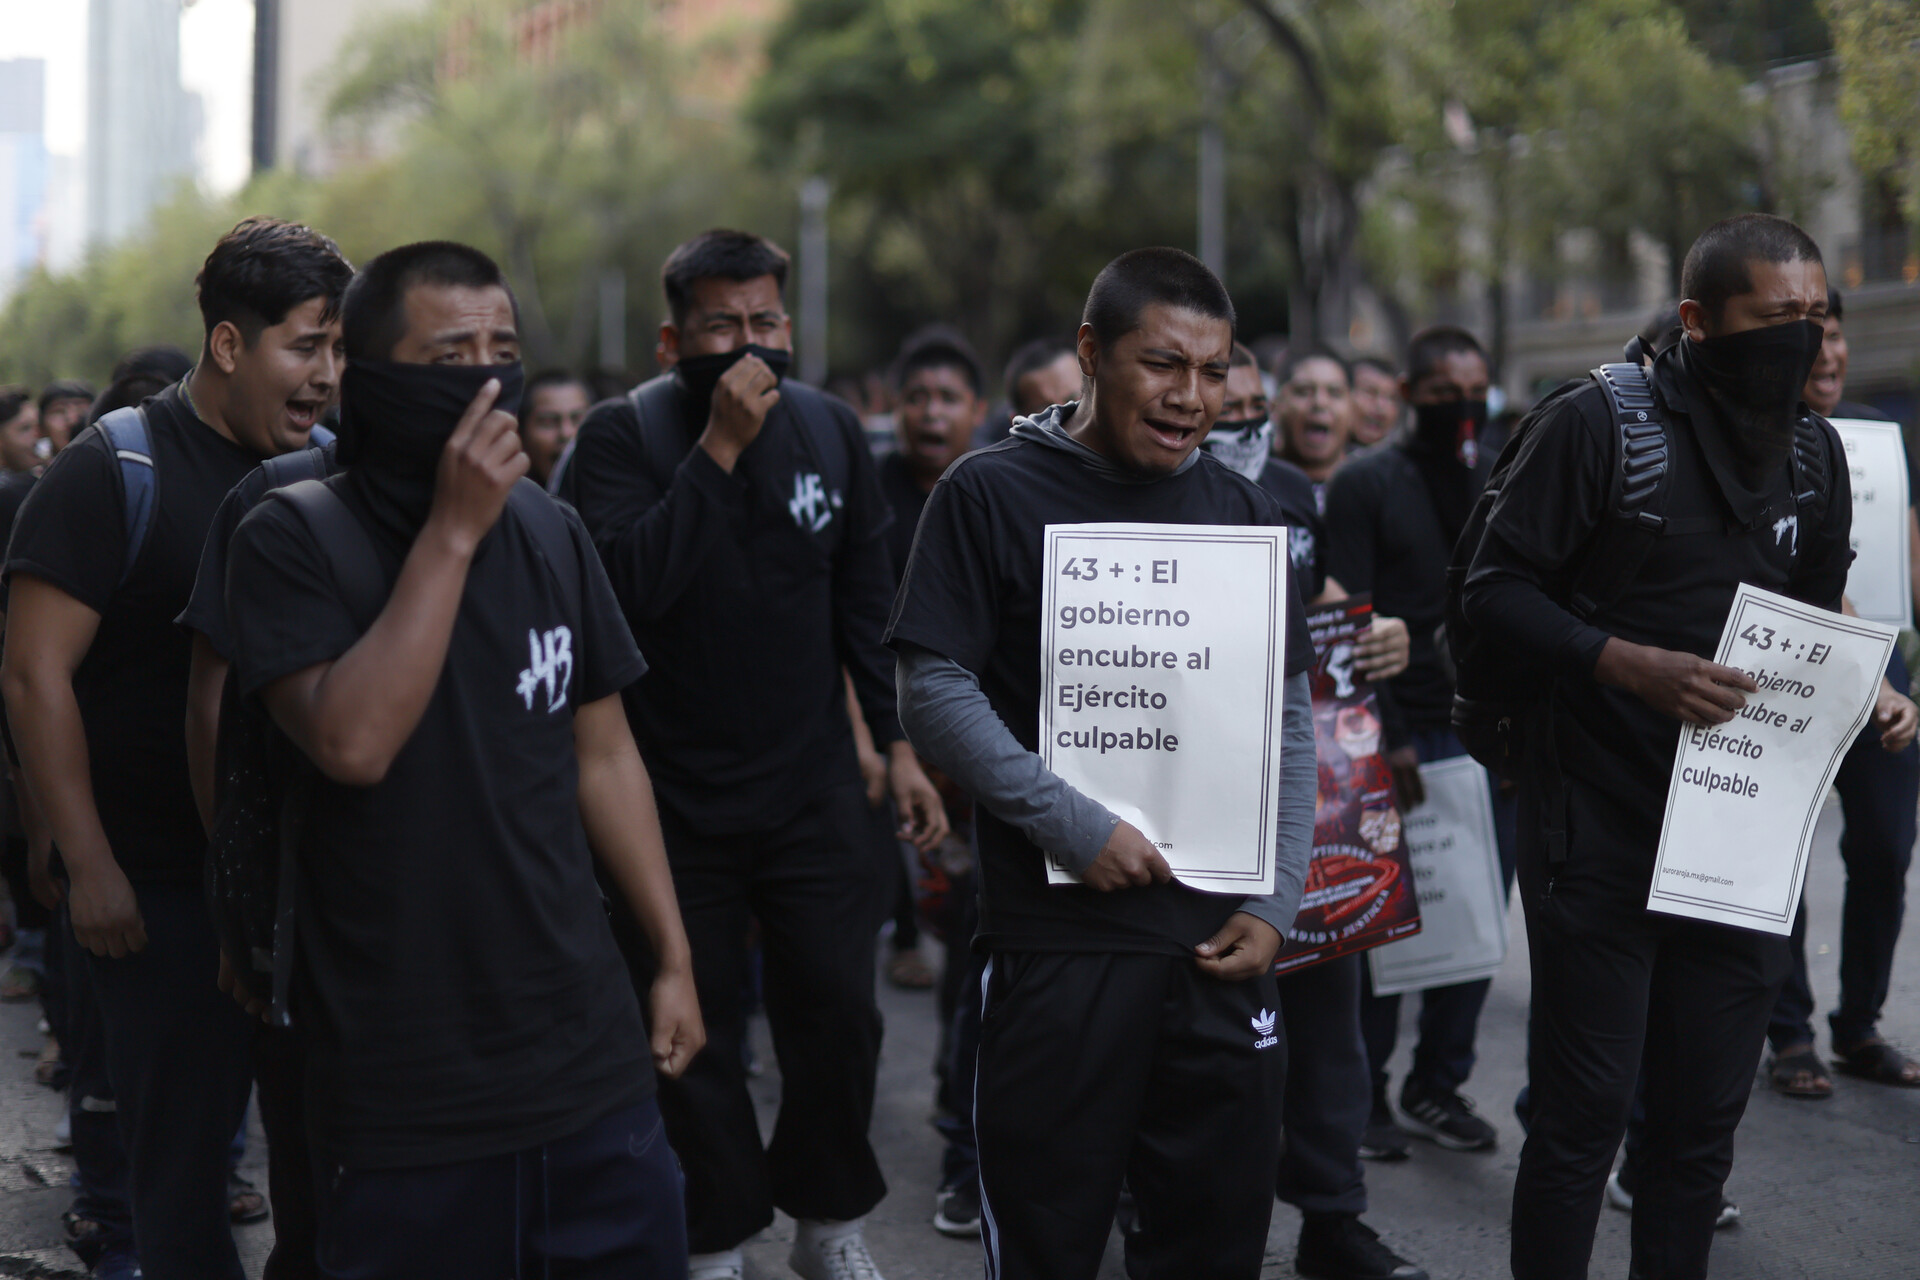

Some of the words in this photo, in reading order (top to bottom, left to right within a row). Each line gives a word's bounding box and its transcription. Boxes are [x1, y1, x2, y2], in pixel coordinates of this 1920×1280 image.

[1061, 557, 1099, 582] 43
[1109, 562, 1124, 579] +
[1134, 564, 1142, 584] :
[1151, 559, 1178, 584] El
[1059, 600, 1190, 630] gobierno
[1058, 645, 1178, 670] encubre
[1186, 646, 1211, 671] al
[1739, 623, 1776, 651] 43
[1780, 638, 1792, 653] +
[1806, 642, 1832, 665] El
[1058, 683, 1168, 713] Ejército
[1733, 667, 1816, 699] obierno
[1736, 702, 1788, 728] ubre
[1790, 716, 1812, 734] al
[1056, 725, 1179, 754] culpable
[1691, 726, 1763, 760] Ejército
[1682, 766, 1760, 798] culpable
[1254, 1035, 1278, 1049] adidas
